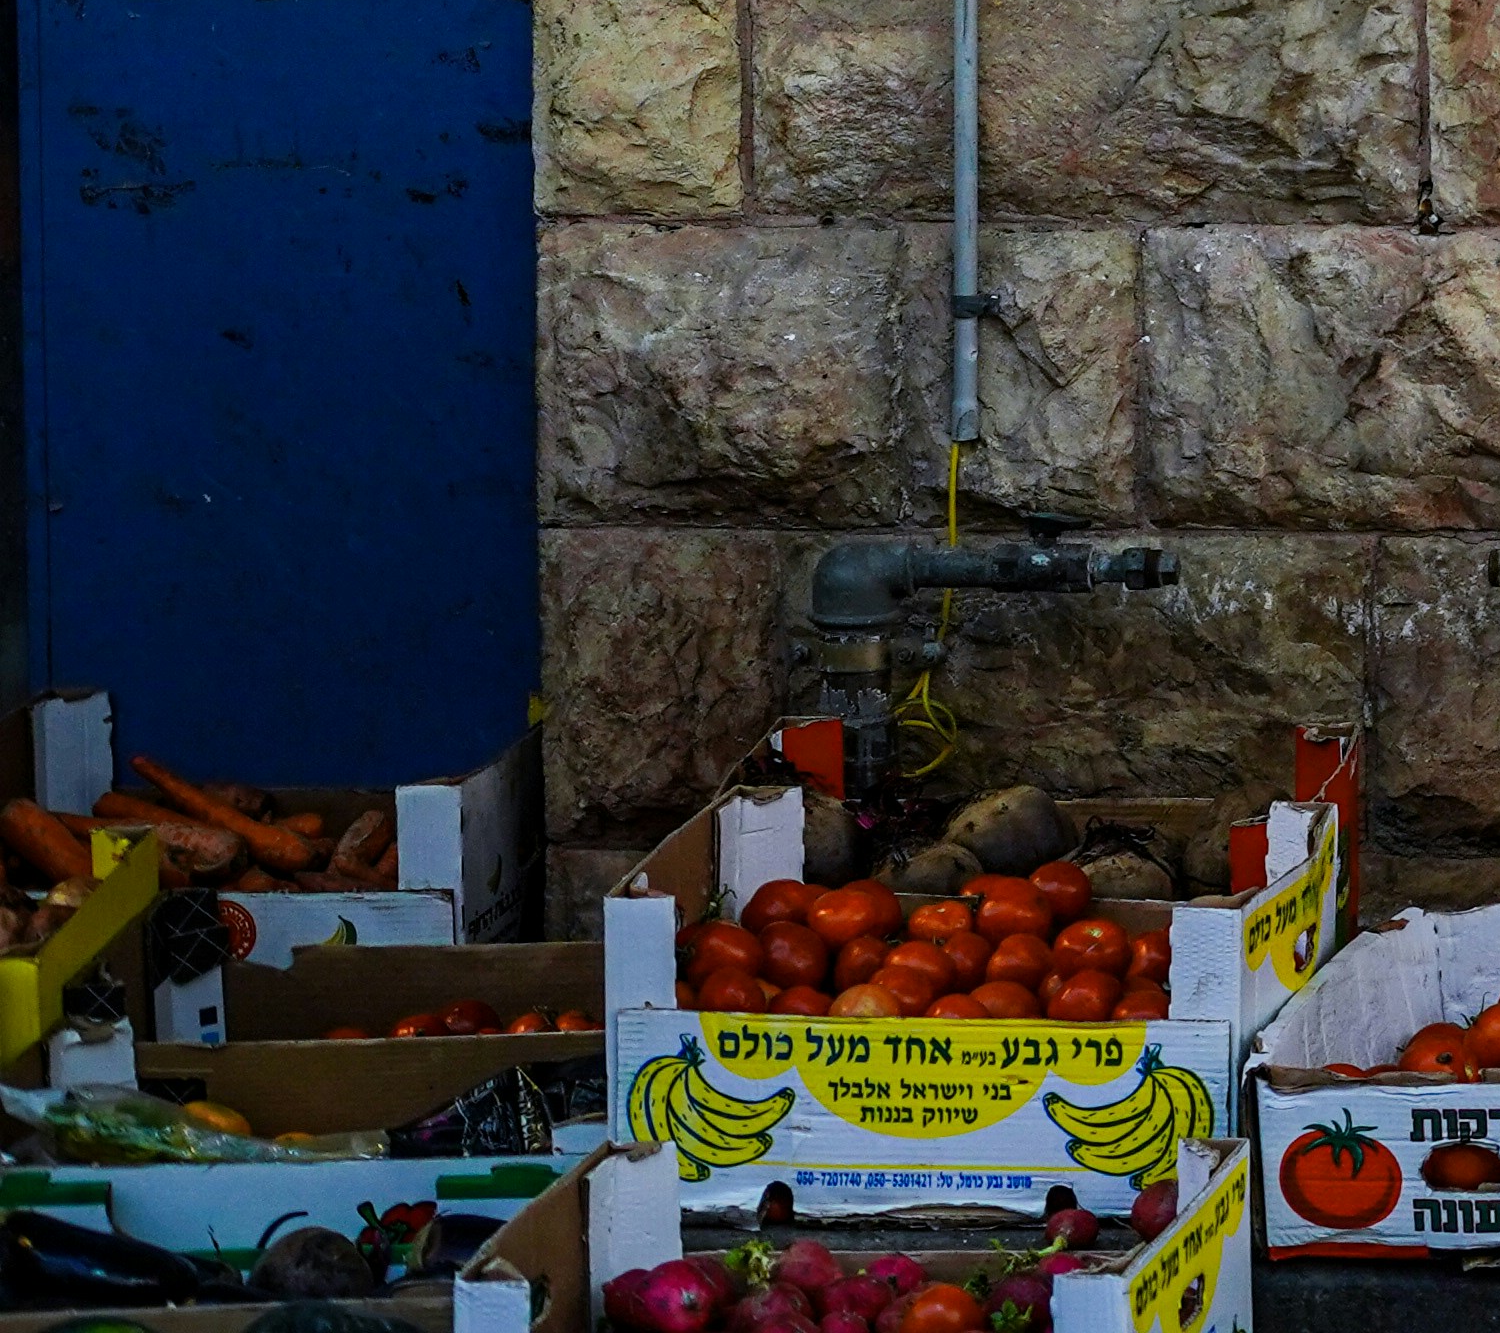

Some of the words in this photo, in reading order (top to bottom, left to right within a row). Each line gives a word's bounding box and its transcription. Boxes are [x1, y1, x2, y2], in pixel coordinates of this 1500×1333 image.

[717, 1024, 794, 1061] כולם
[806, 1028, 871, 1067] מעל
[883, 1035, 954, 1064] אחד
[1001, 1036, 1059, 1067] גבע
[1072, 1033, 1123, 1068] פרי
[900, 1077, 973, 1101] וישראל
[983, 1083, 1012, 1101] בני
[859, 1105, 914, 1124] בננות
[922, 1106, 979, 1128] שיווק
